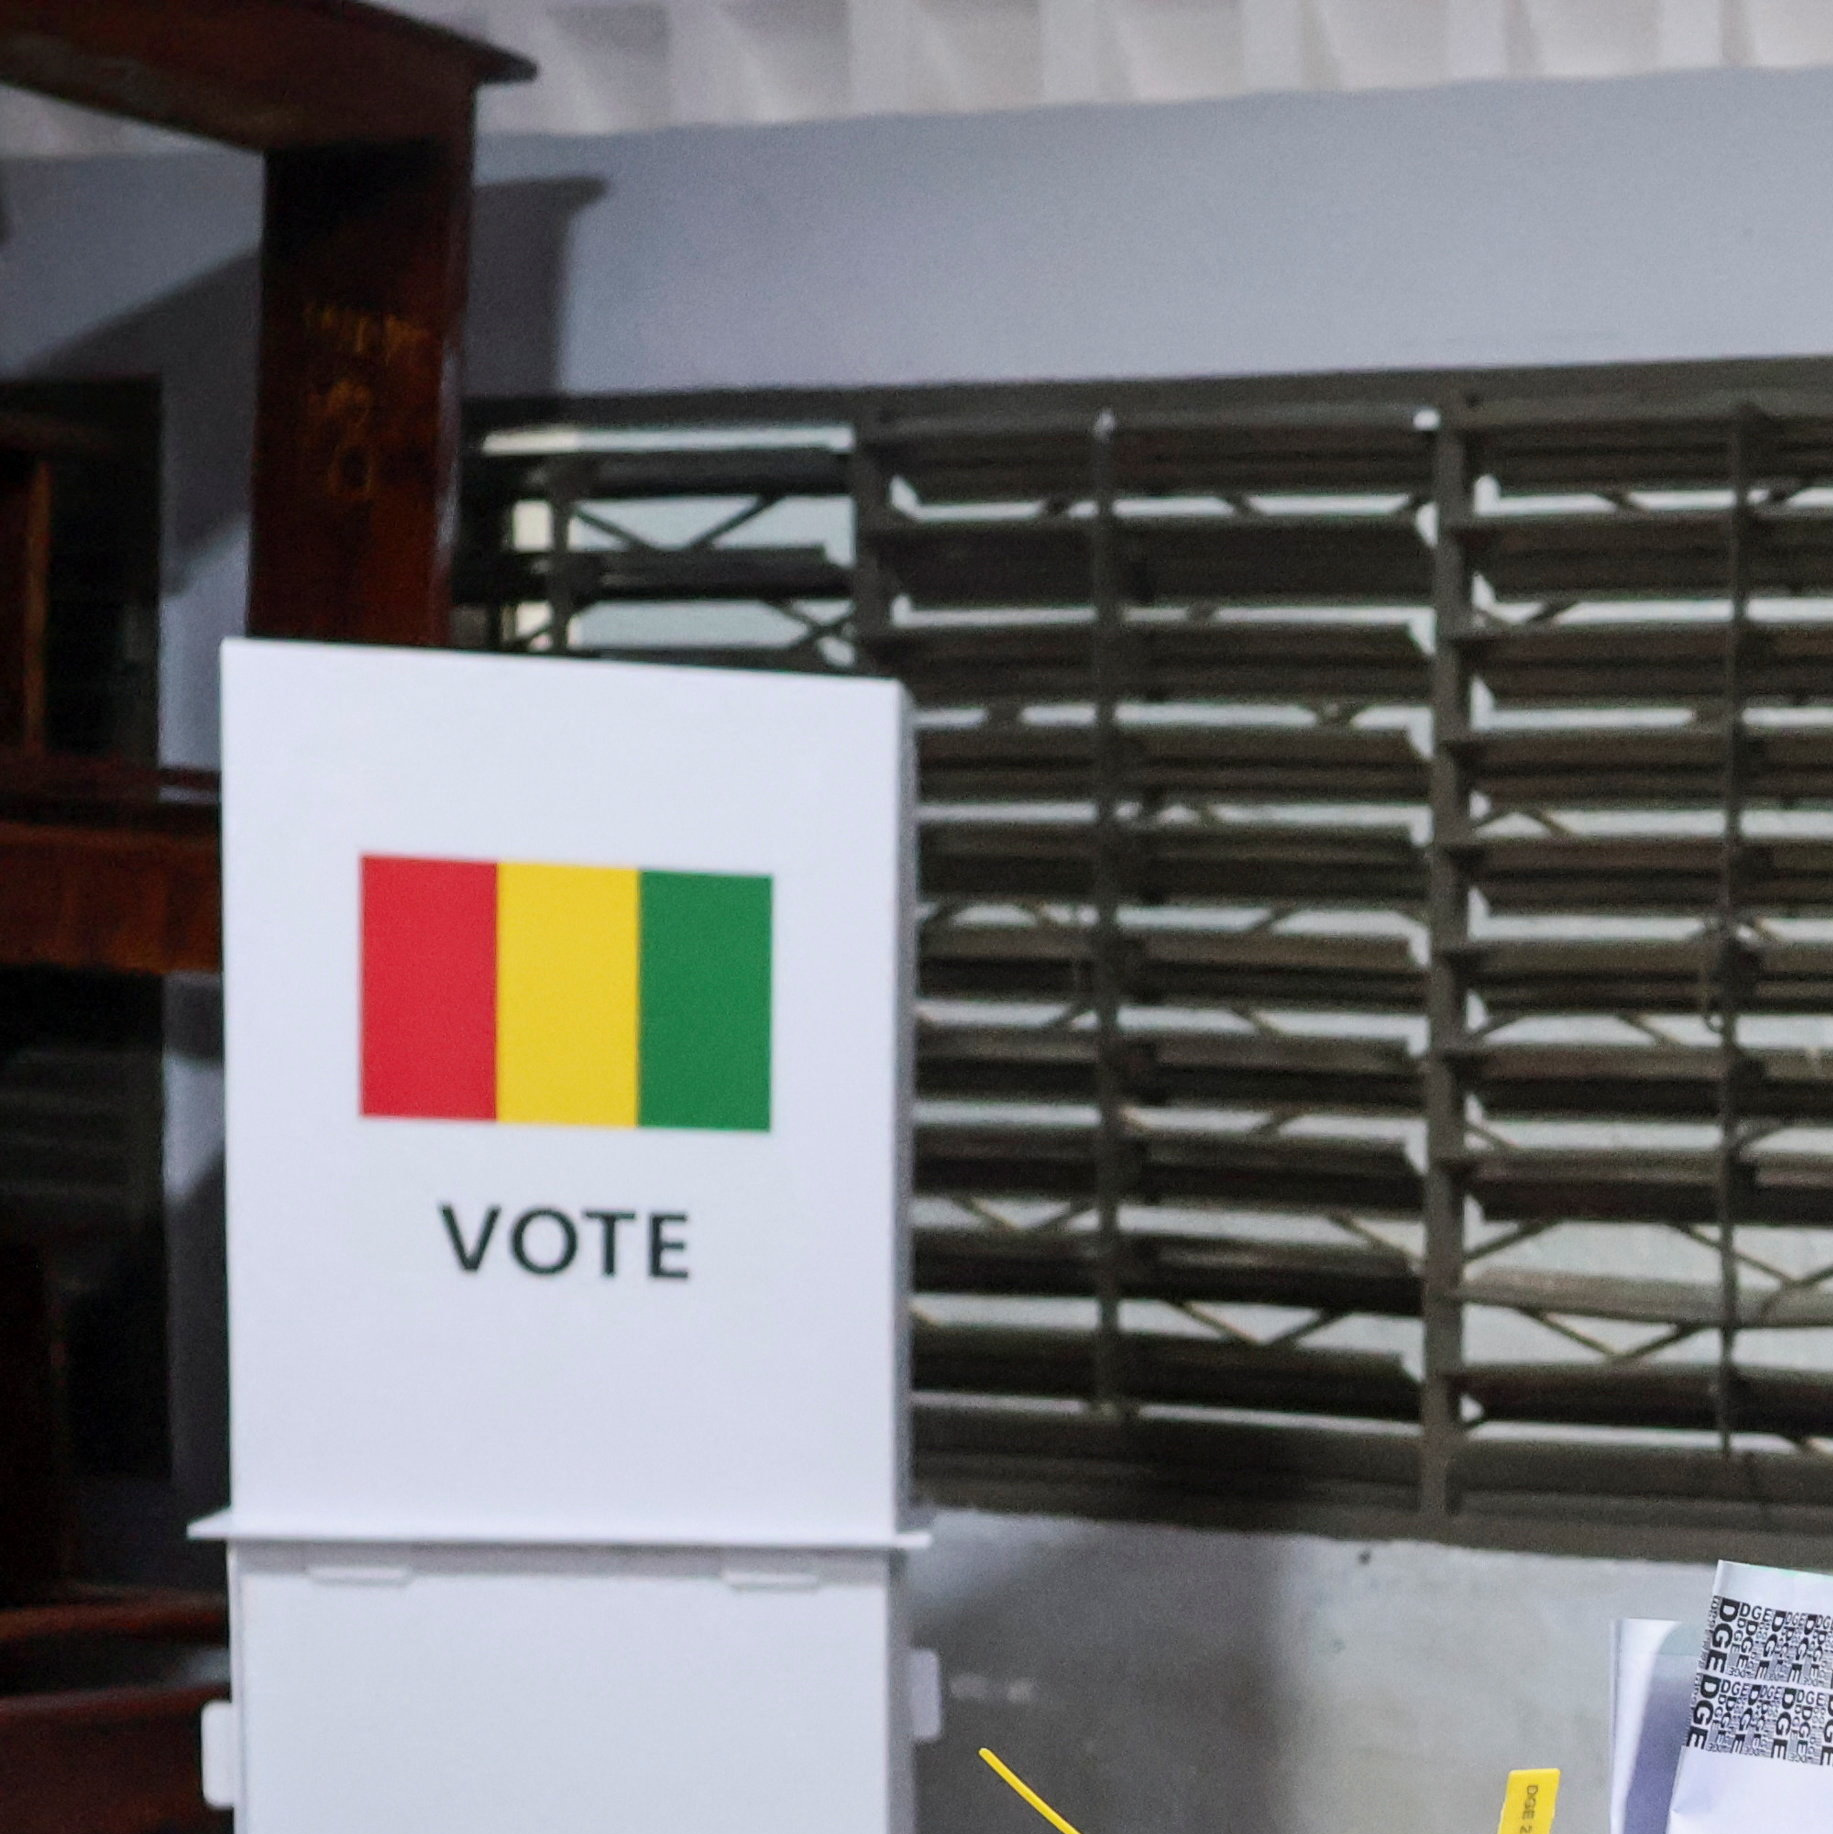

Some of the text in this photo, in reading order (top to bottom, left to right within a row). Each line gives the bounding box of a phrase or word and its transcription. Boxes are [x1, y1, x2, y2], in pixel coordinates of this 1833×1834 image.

[439, 1203, 689, 1279] VOTE
[1705, 1597, 1740, 1673] DGE
[1740, 1602, 1773, 1622] DGE
[1736, 1620, 1758, 1668] DGE
[1686, 1674, 1721, 1749] DGE
[1721, 1679, 1751, 1696] DGE
[1797, 1689, 1827, 1706] DGE
[1770, 1687, 1796, 1760] DGE
[1522, 1785, 1538, 1820] DGE
